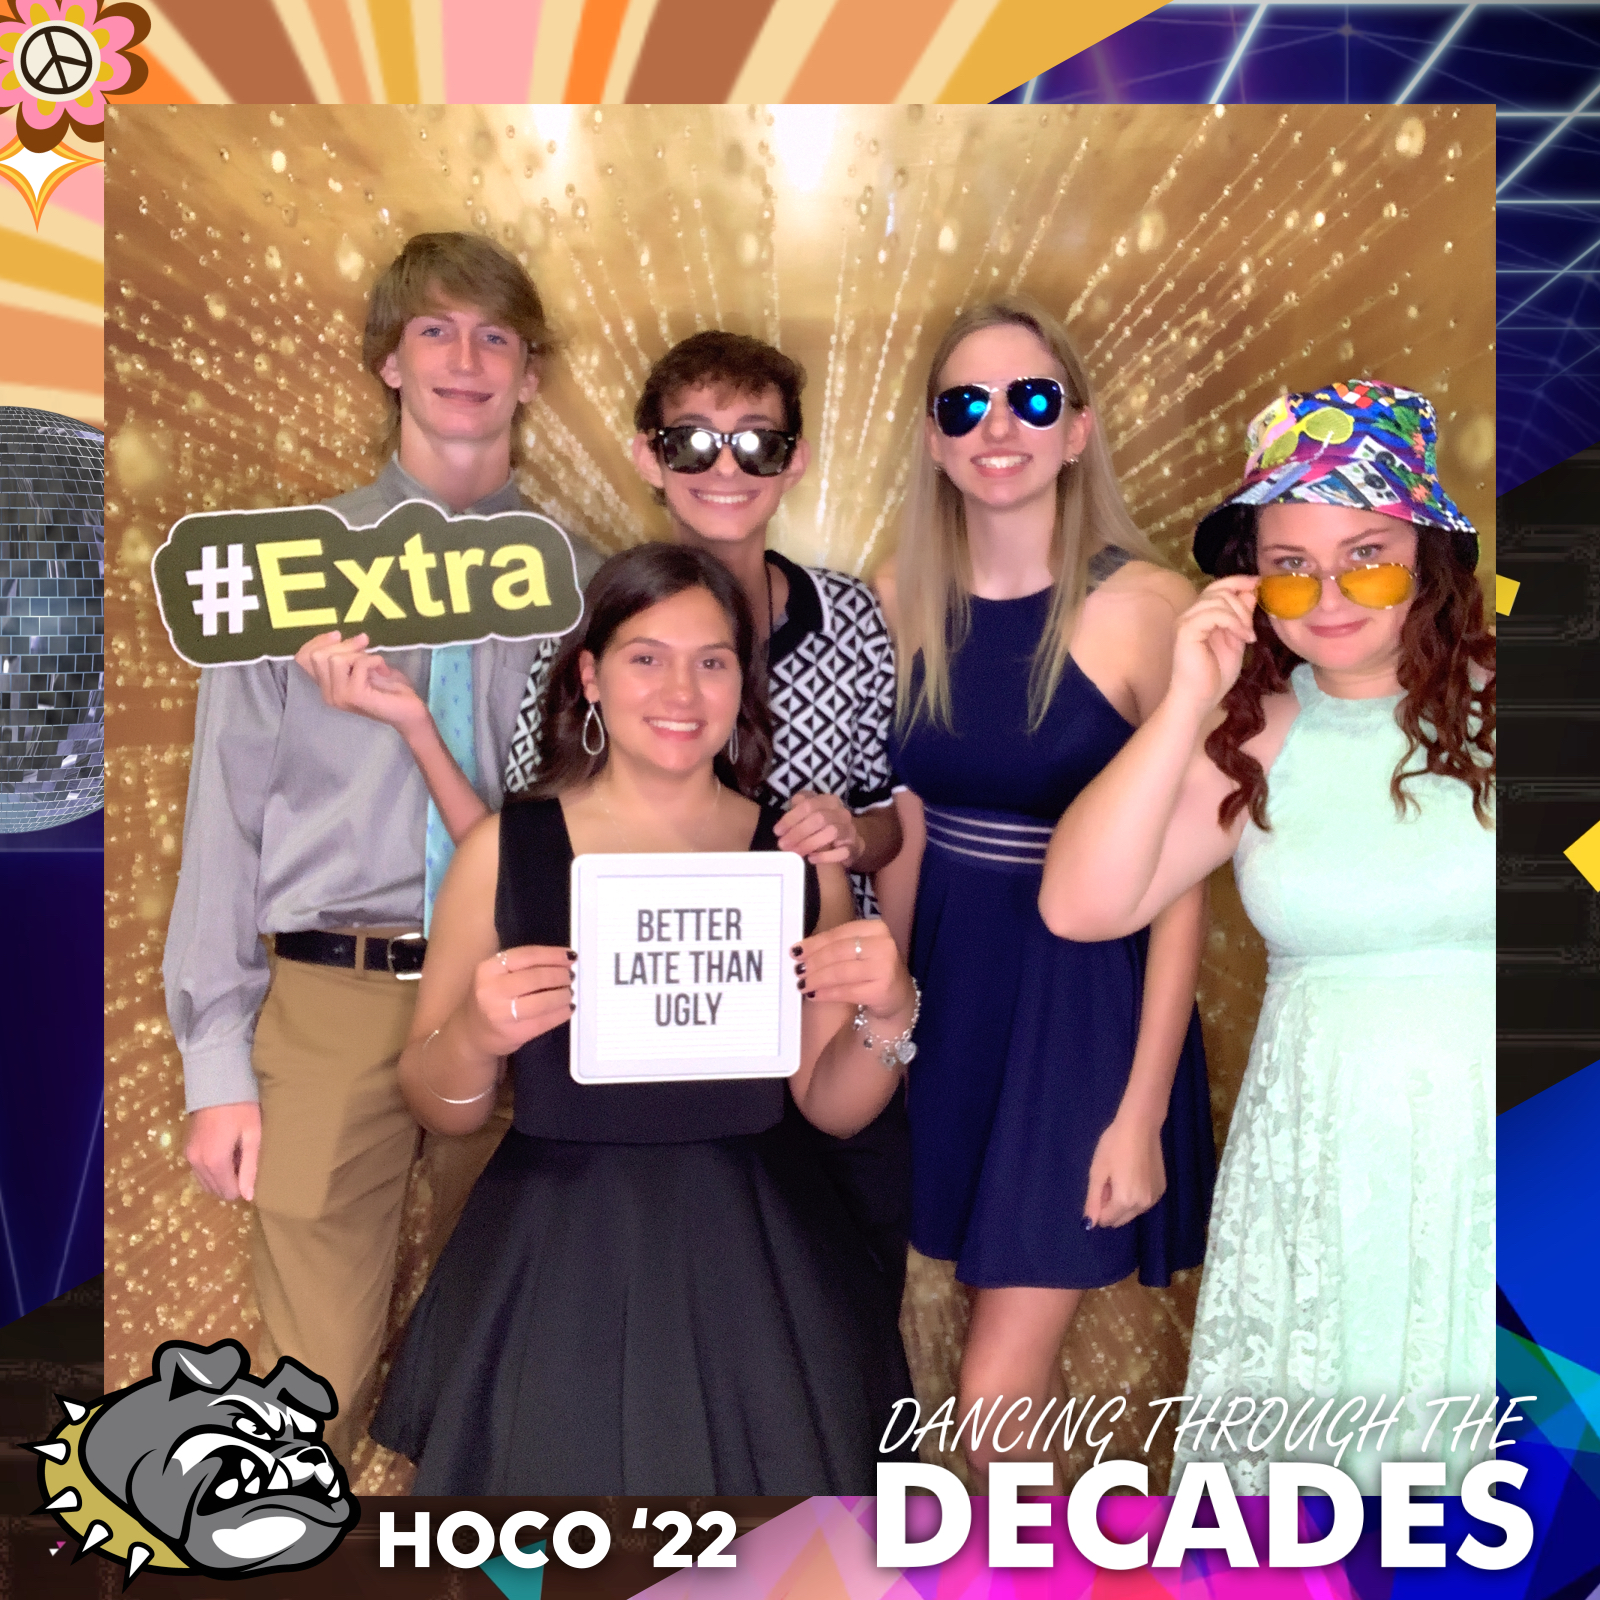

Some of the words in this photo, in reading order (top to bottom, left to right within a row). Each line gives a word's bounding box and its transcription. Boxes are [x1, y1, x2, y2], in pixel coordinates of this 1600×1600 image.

[186, 533, 552, 636] #Extra
[637, 908, 742, 942] BETTER
[614, 951, 681, 985] LATE
[689, 950, 763, 983] THAN
[655, 992, 723, 1027] UGLY
